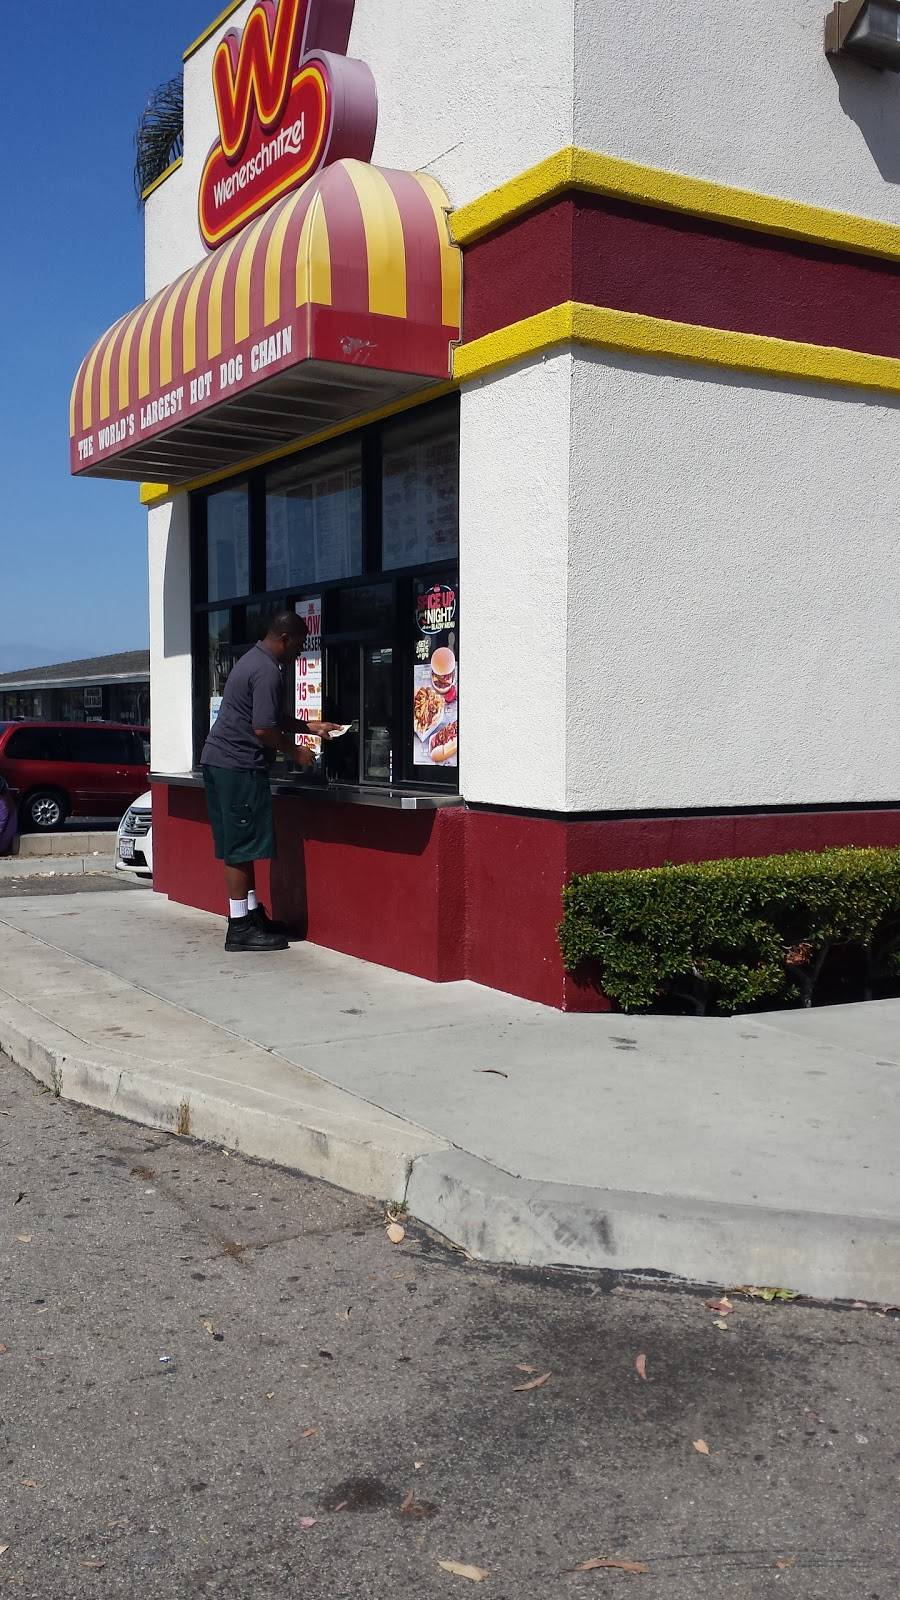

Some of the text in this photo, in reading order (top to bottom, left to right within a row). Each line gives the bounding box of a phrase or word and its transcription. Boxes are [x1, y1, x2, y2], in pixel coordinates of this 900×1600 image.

[212, 0, 300, 157] W
[213, 111, 305, 209] Wienerschnitzel
[78, 325, 293, 461] THE WORLD'S LARGEST HOT DOG CHAIN
